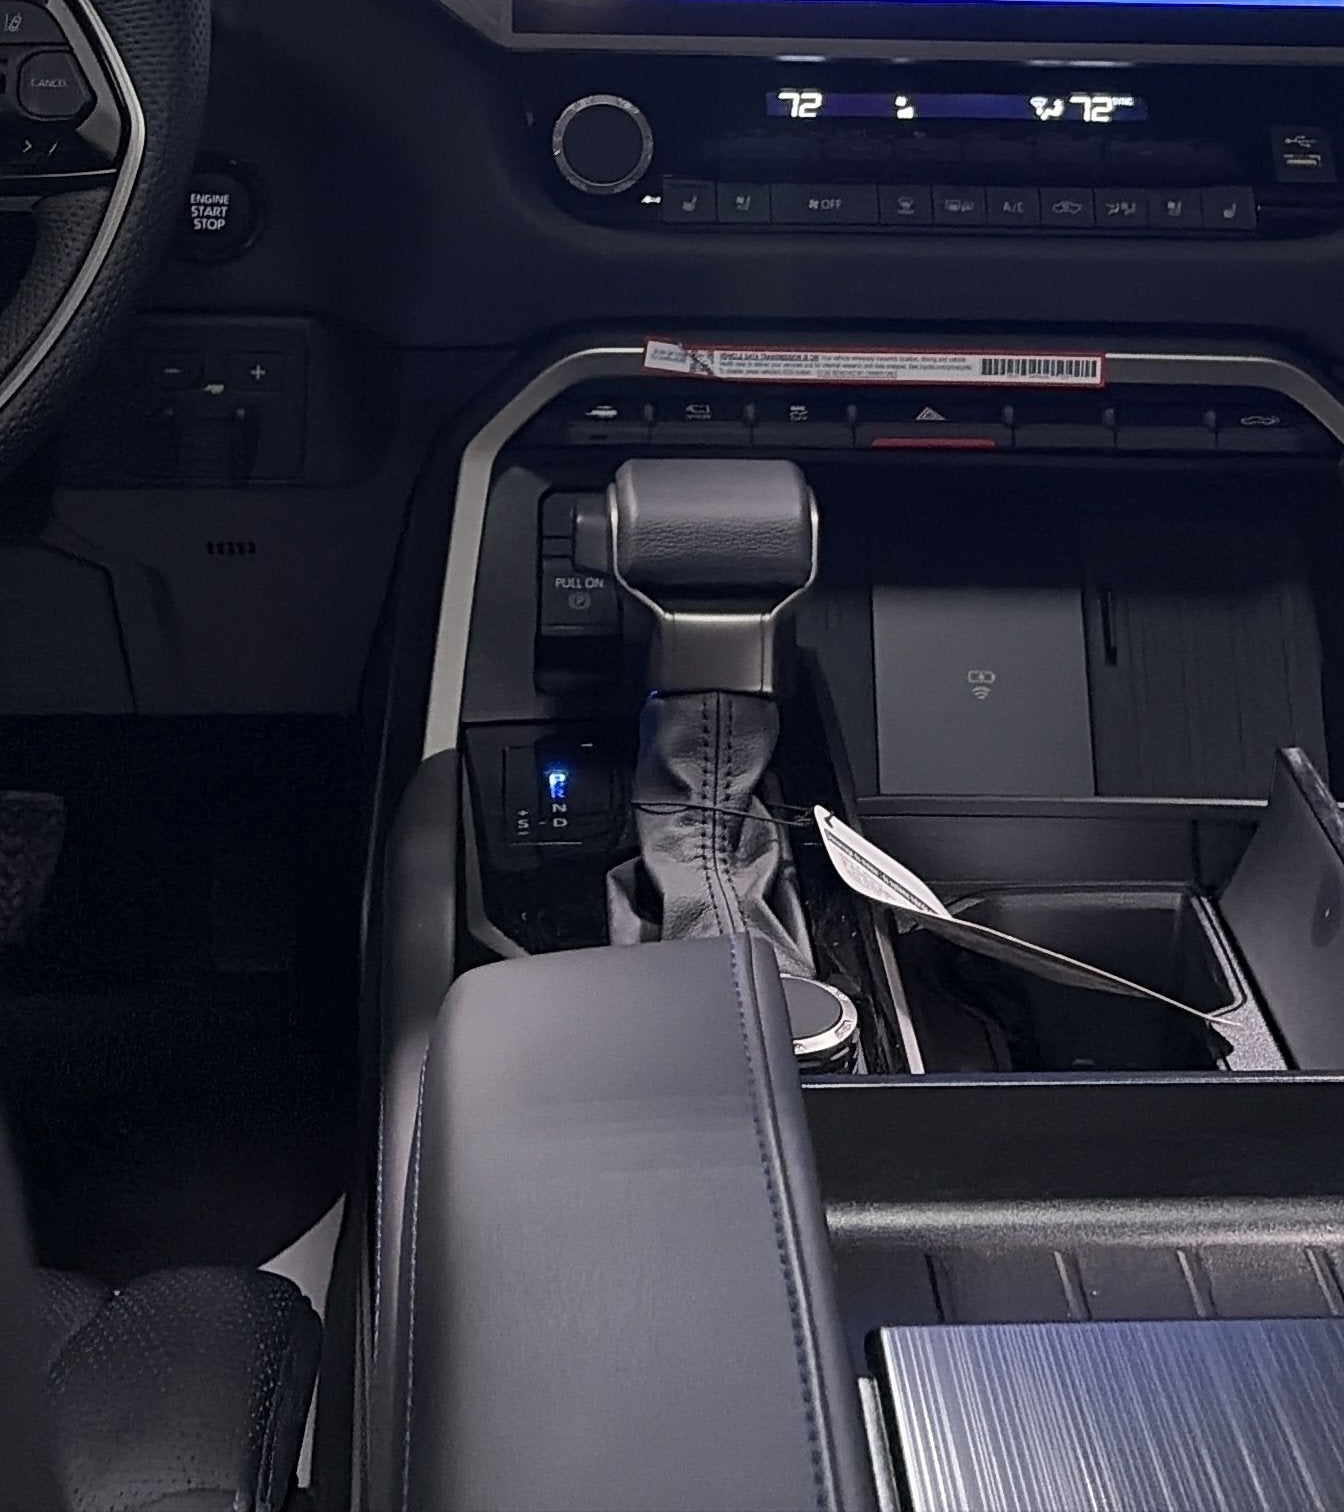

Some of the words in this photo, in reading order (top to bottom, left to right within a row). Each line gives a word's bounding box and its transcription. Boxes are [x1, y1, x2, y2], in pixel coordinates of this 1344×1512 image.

[777, 91, 824, 119] 72
[1069, 95, 1113, 123] 72
[190, 193, 230, 205] ENGINE
[820, 198, 843, 210] OFF
[191, 205, 229, 218] START
[1003, 201, 1024, 214] A/C
[193, 217, 226, 230] STOP
[554, 576, 582, 589] PULL
[584, 576, 604, 589] ON
[552, 802, 567, 813] N
[517, 819, 530, 829] S
[552, 817, 568, 828] D
